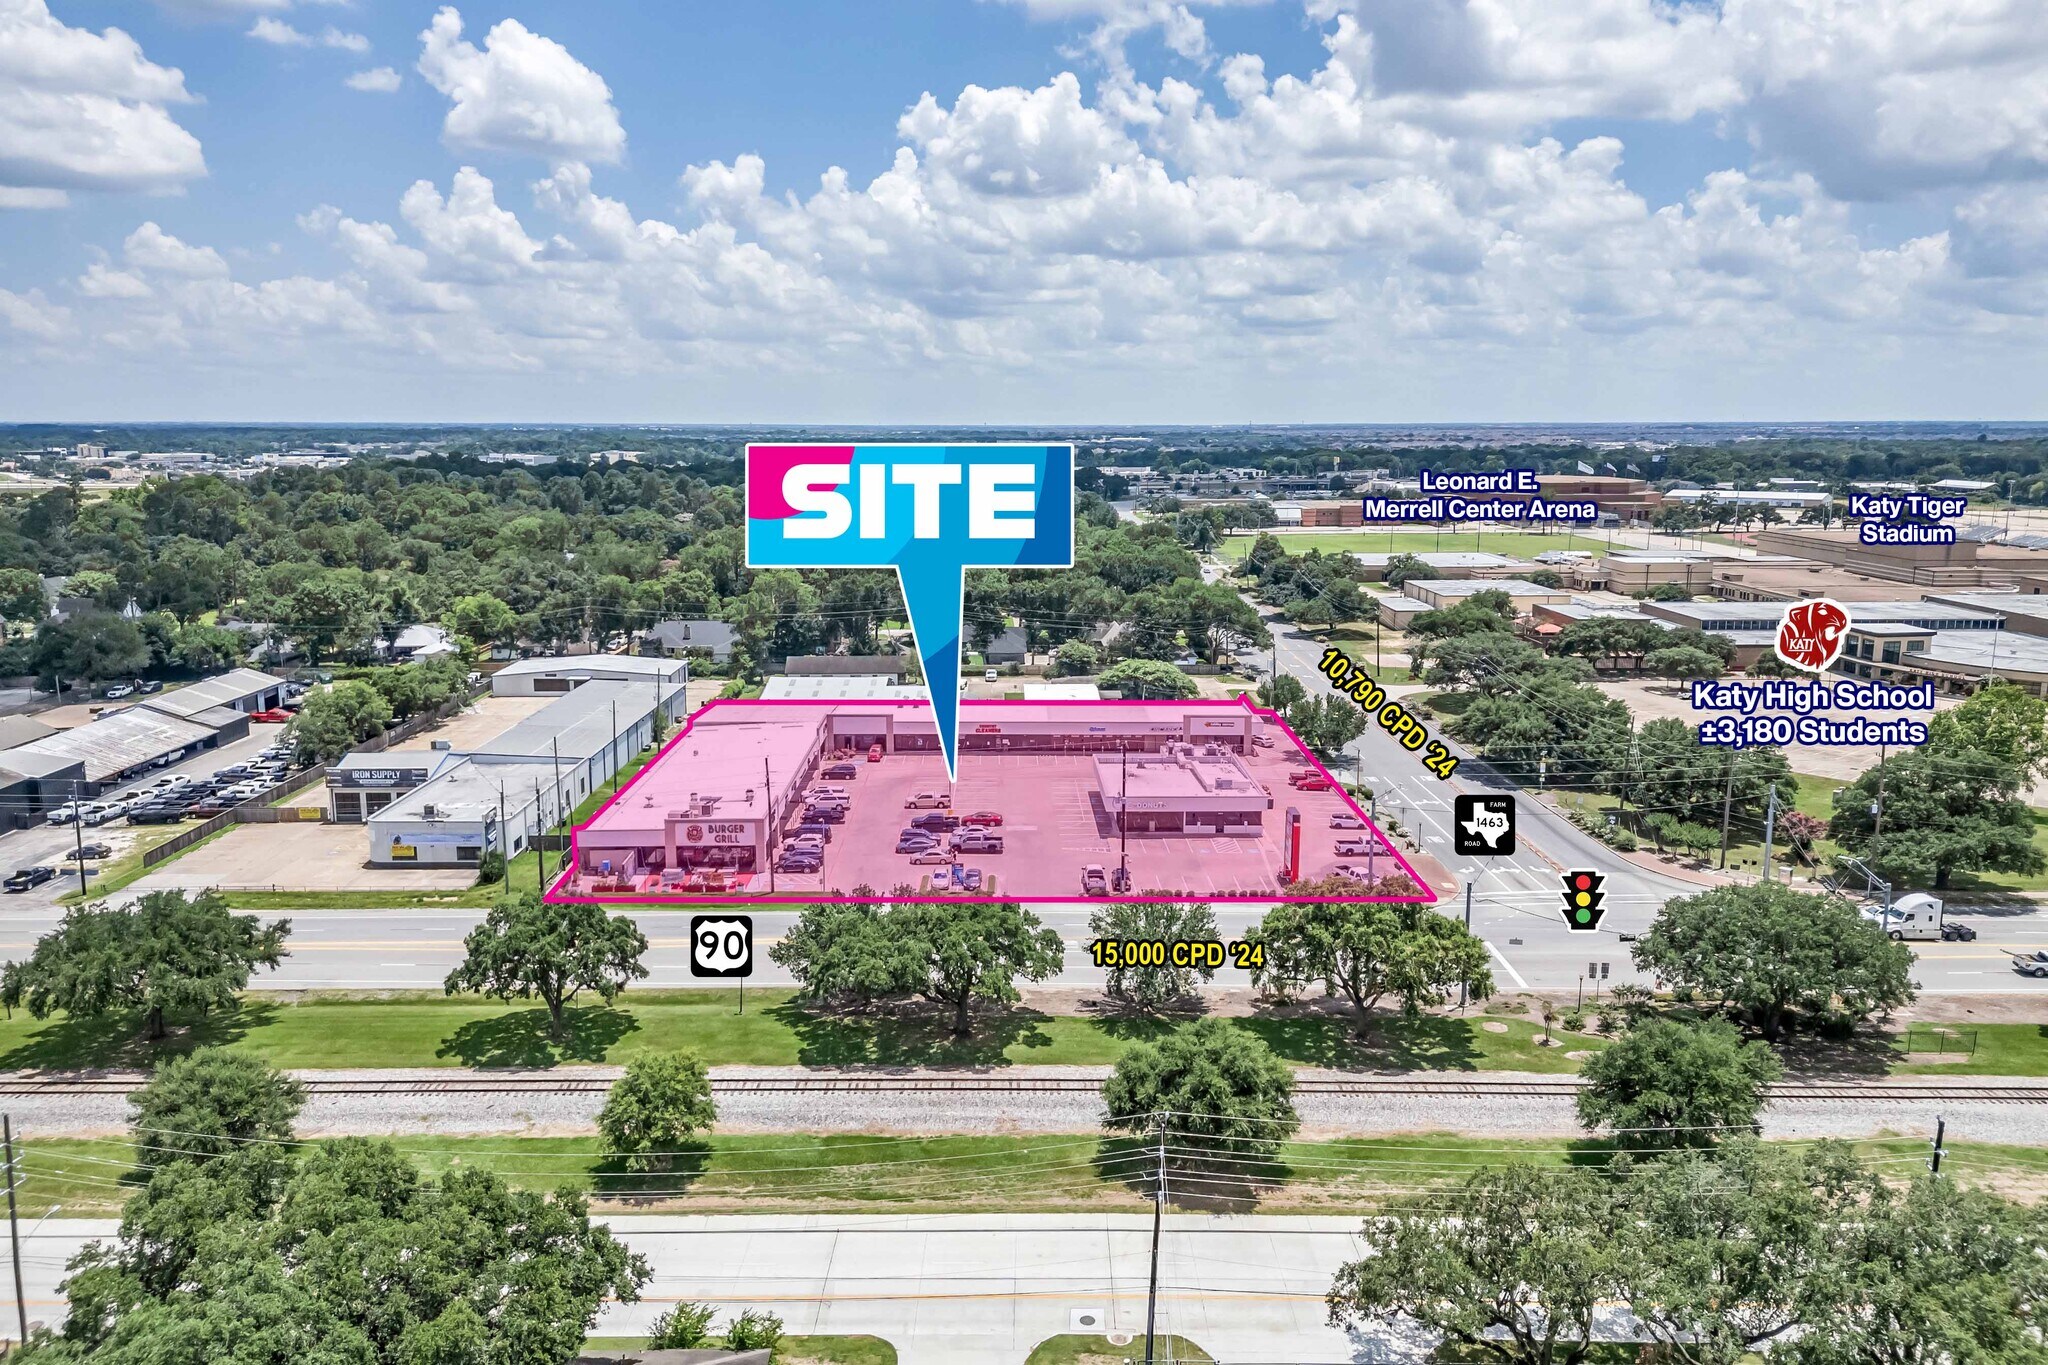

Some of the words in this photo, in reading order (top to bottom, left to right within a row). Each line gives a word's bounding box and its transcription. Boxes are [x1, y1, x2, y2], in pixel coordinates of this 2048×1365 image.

[352, 770, 371, 779] IRON
[372, 770, 401, 779] SUPPLY
[708, 824, 745, 834] BURGER
[714, 834, 740, 844] GRILL
